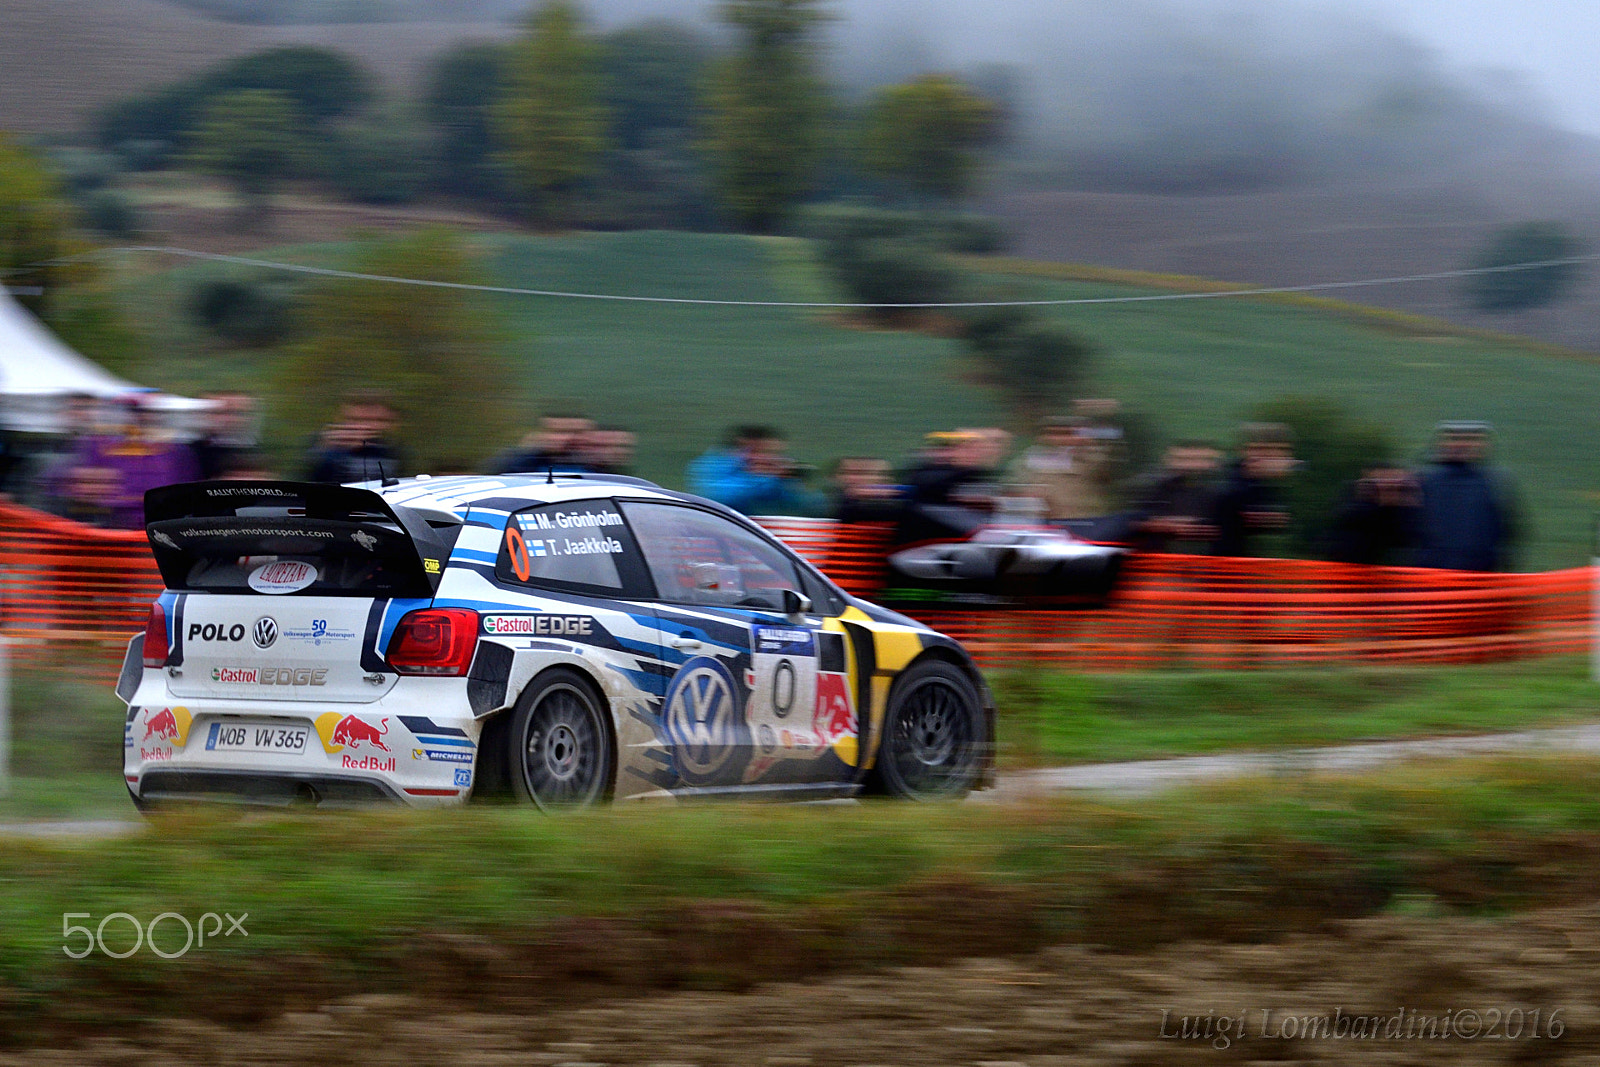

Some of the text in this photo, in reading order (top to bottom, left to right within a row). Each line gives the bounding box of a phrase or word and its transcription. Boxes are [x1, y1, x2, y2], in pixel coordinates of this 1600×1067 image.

[535, 511, 624, 530] M. Grönholm
[179, 527, 335, 540] volkswagen-motorsport.com
[506, 527, 530, 582] 0
[546, 537, 623, 556] T. Jaakkola
[259, 563, 310, 584] LAURETANA
[424, 560, 440, 571] OMP
[188, 623, 246, 642] POLO
[312, 619, 327, 631] 50
[496, 616, 593, 635] Castrol EDGE
[220, 667, 329, 686] Castrol EDGE
[219, 728, 307, 749] WOB VW 365
[430, 751, 472, 761] MICHELIN
